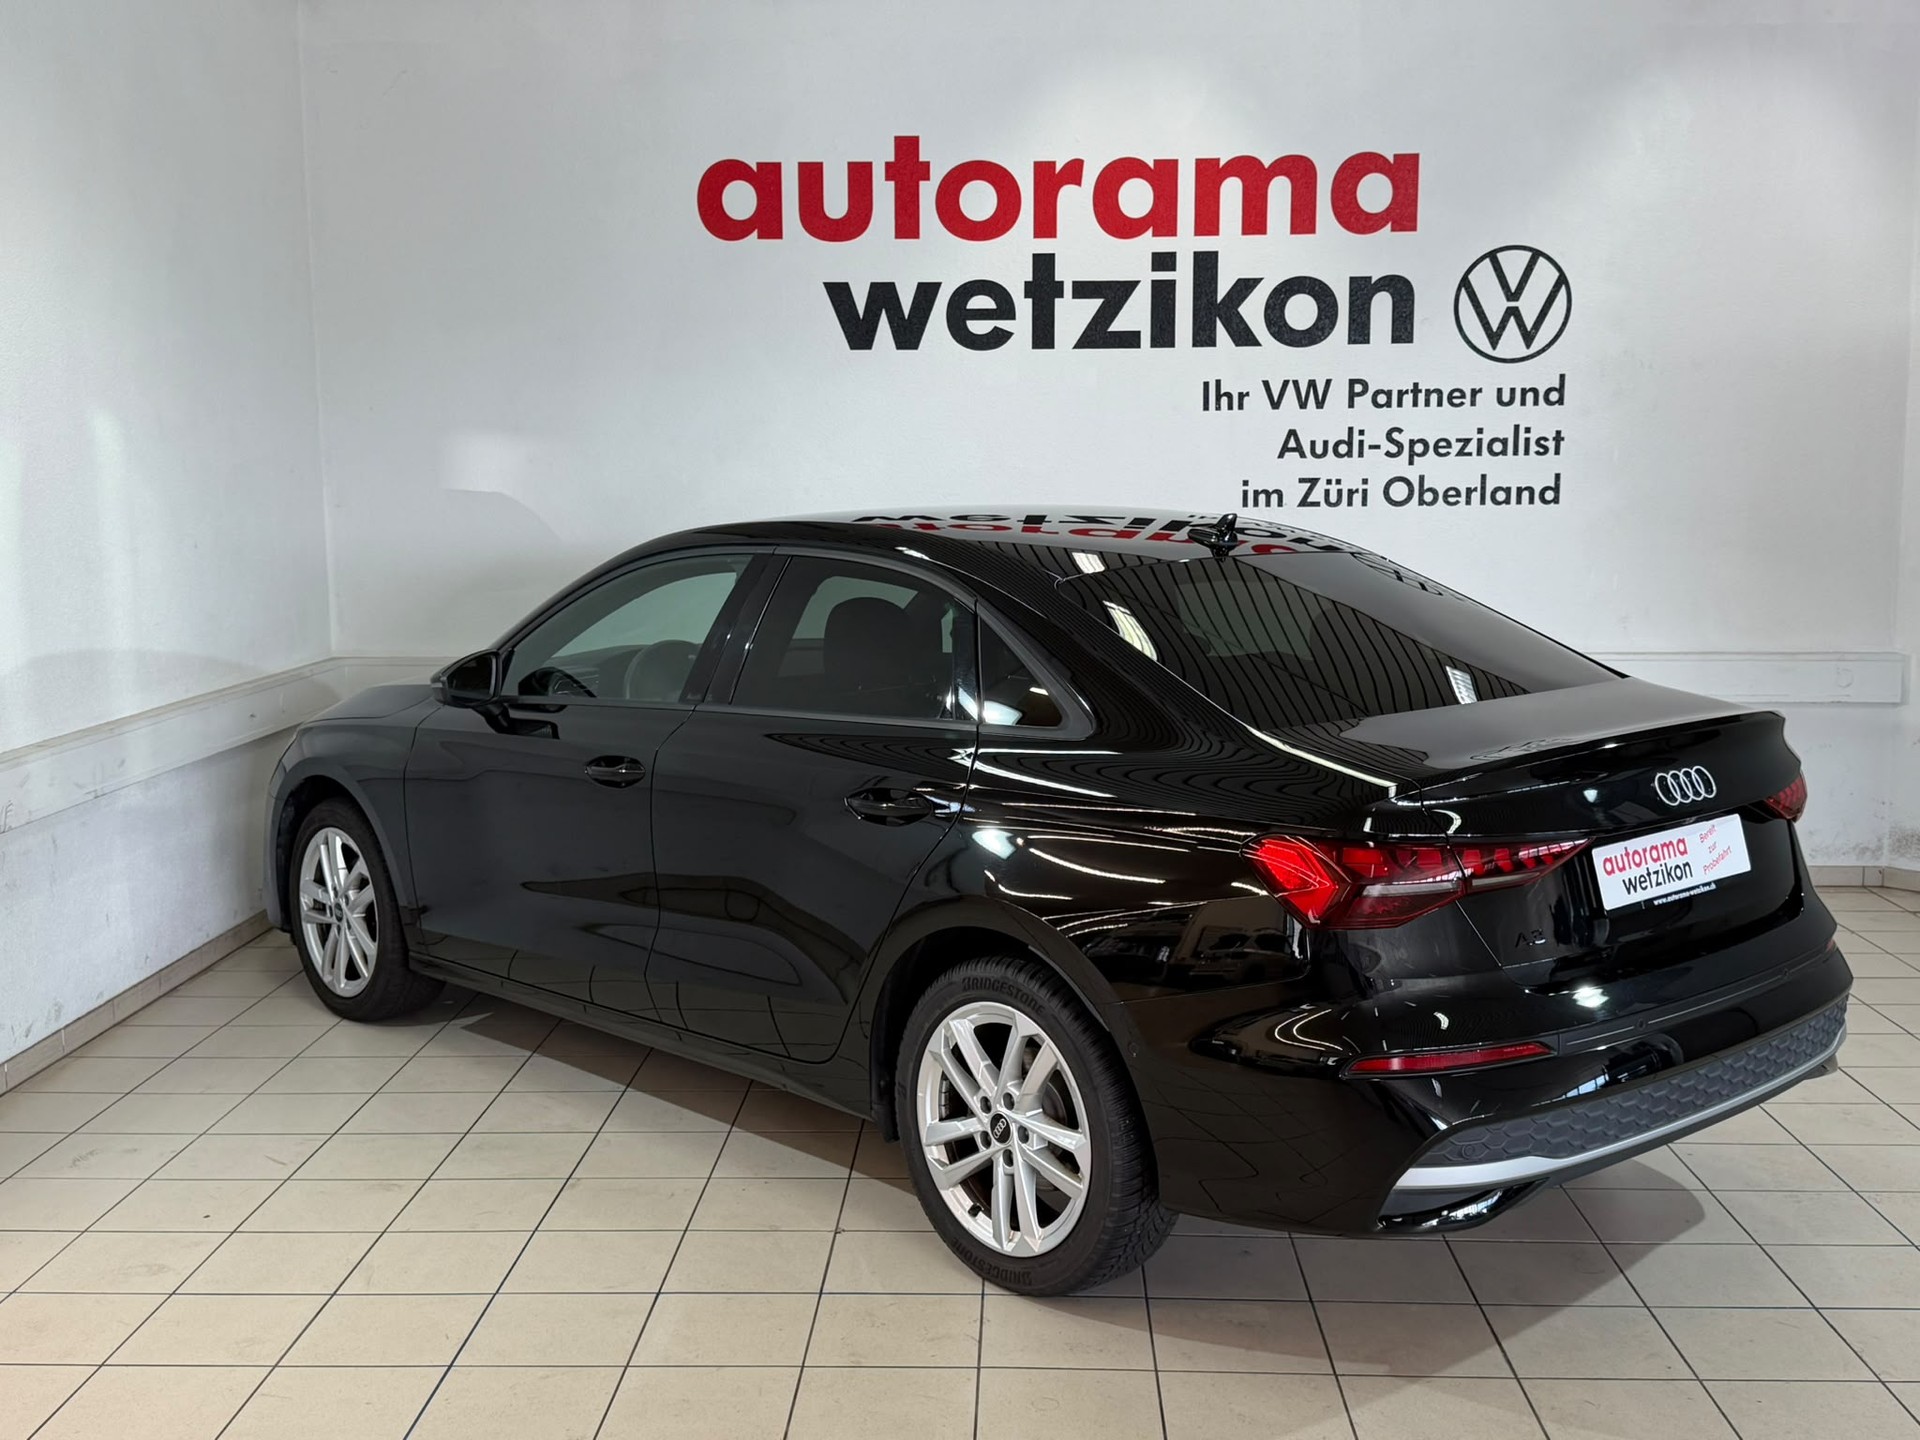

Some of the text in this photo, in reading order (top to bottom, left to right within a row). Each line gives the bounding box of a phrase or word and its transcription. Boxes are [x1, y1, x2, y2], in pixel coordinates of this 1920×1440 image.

[697, 135, 1420, 242] autorama
[823, 251, 1415, 351] wetzikon
[1203, 374, 1566, 411] Ihr VW Partner und
[1278, 424, 1565, 465] Audi-Spezialist
[1242, 473, 1561, 508] im Züri Oberland
[1603, 837, 1688, 876] autorama
[1622, 861, 1693, 895] wetzikon
